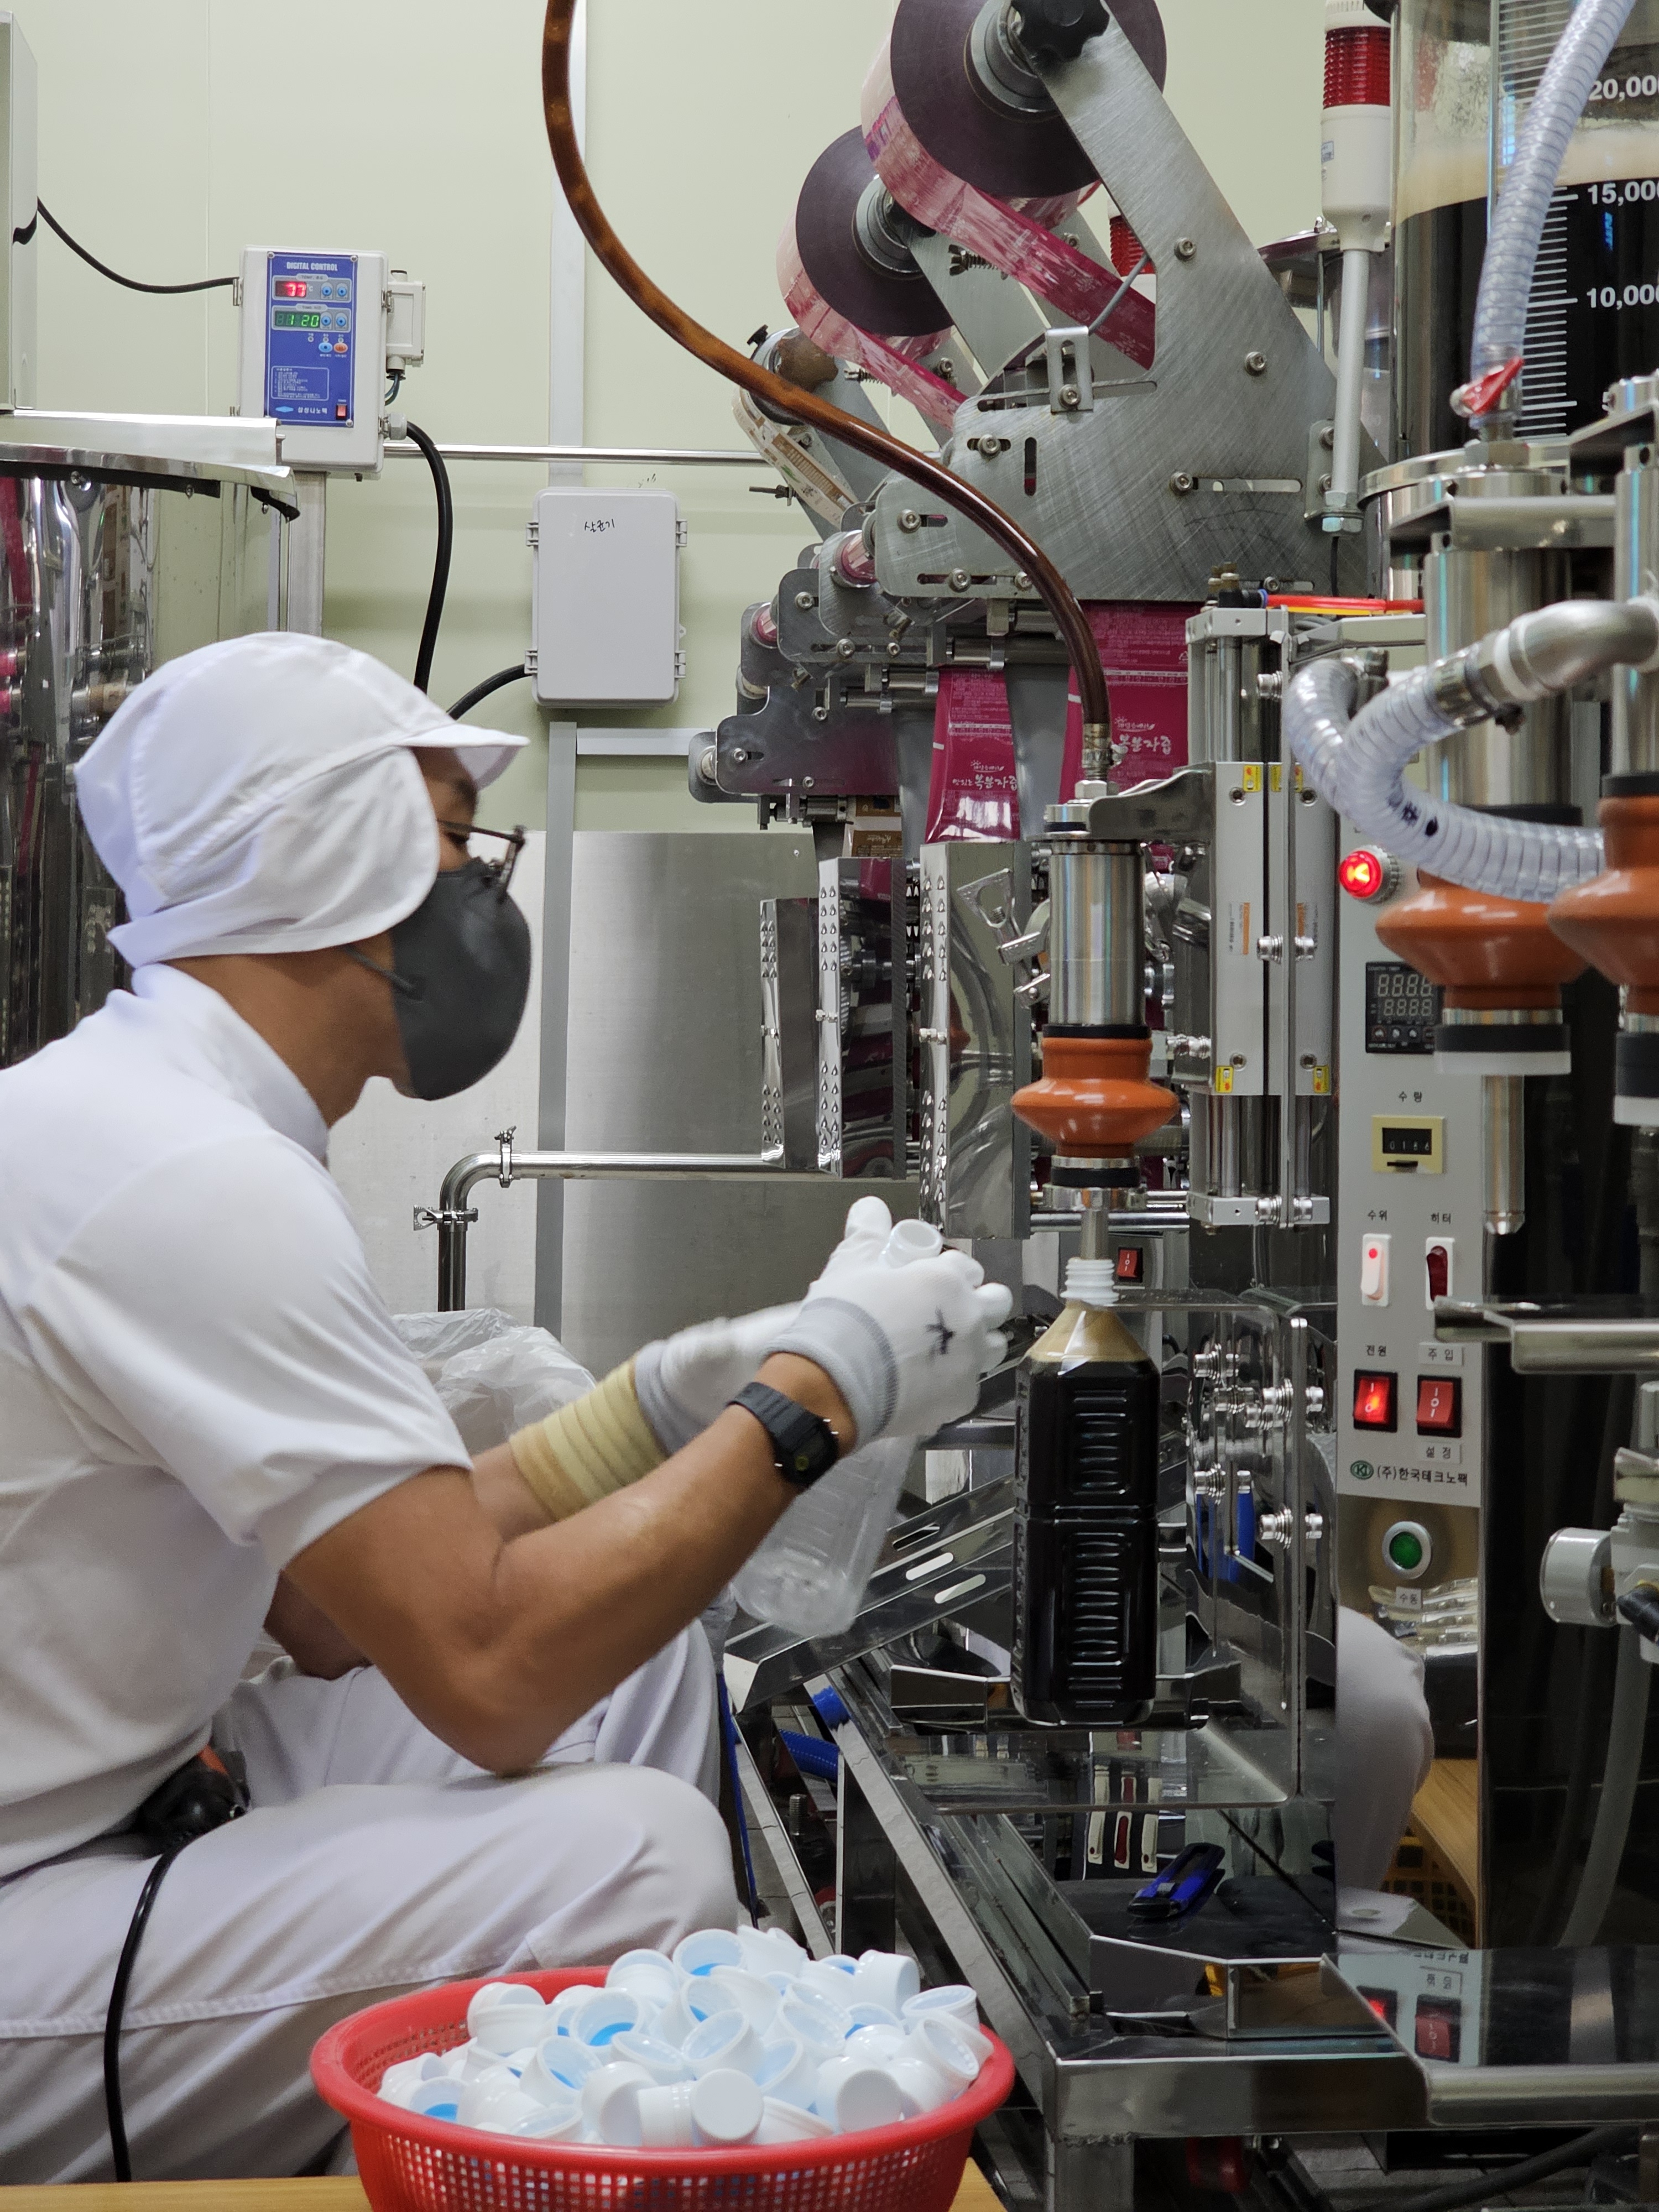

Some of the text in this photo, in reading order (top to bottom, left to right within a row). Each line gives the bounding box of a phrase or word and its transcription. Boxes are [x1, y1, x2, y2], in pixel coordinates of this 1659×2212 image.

[1589, 75, 1659, 102] 20,00
[1588, 180, 1659, 206] 15,00
[286, 262, 338, 271] DIGITAL CONTROL
[1587, 284, 1659, 310] 10,00
[1431, 1212, 1452, 1224] 히터
[1366, 1345, 1387, 1357] 전원
